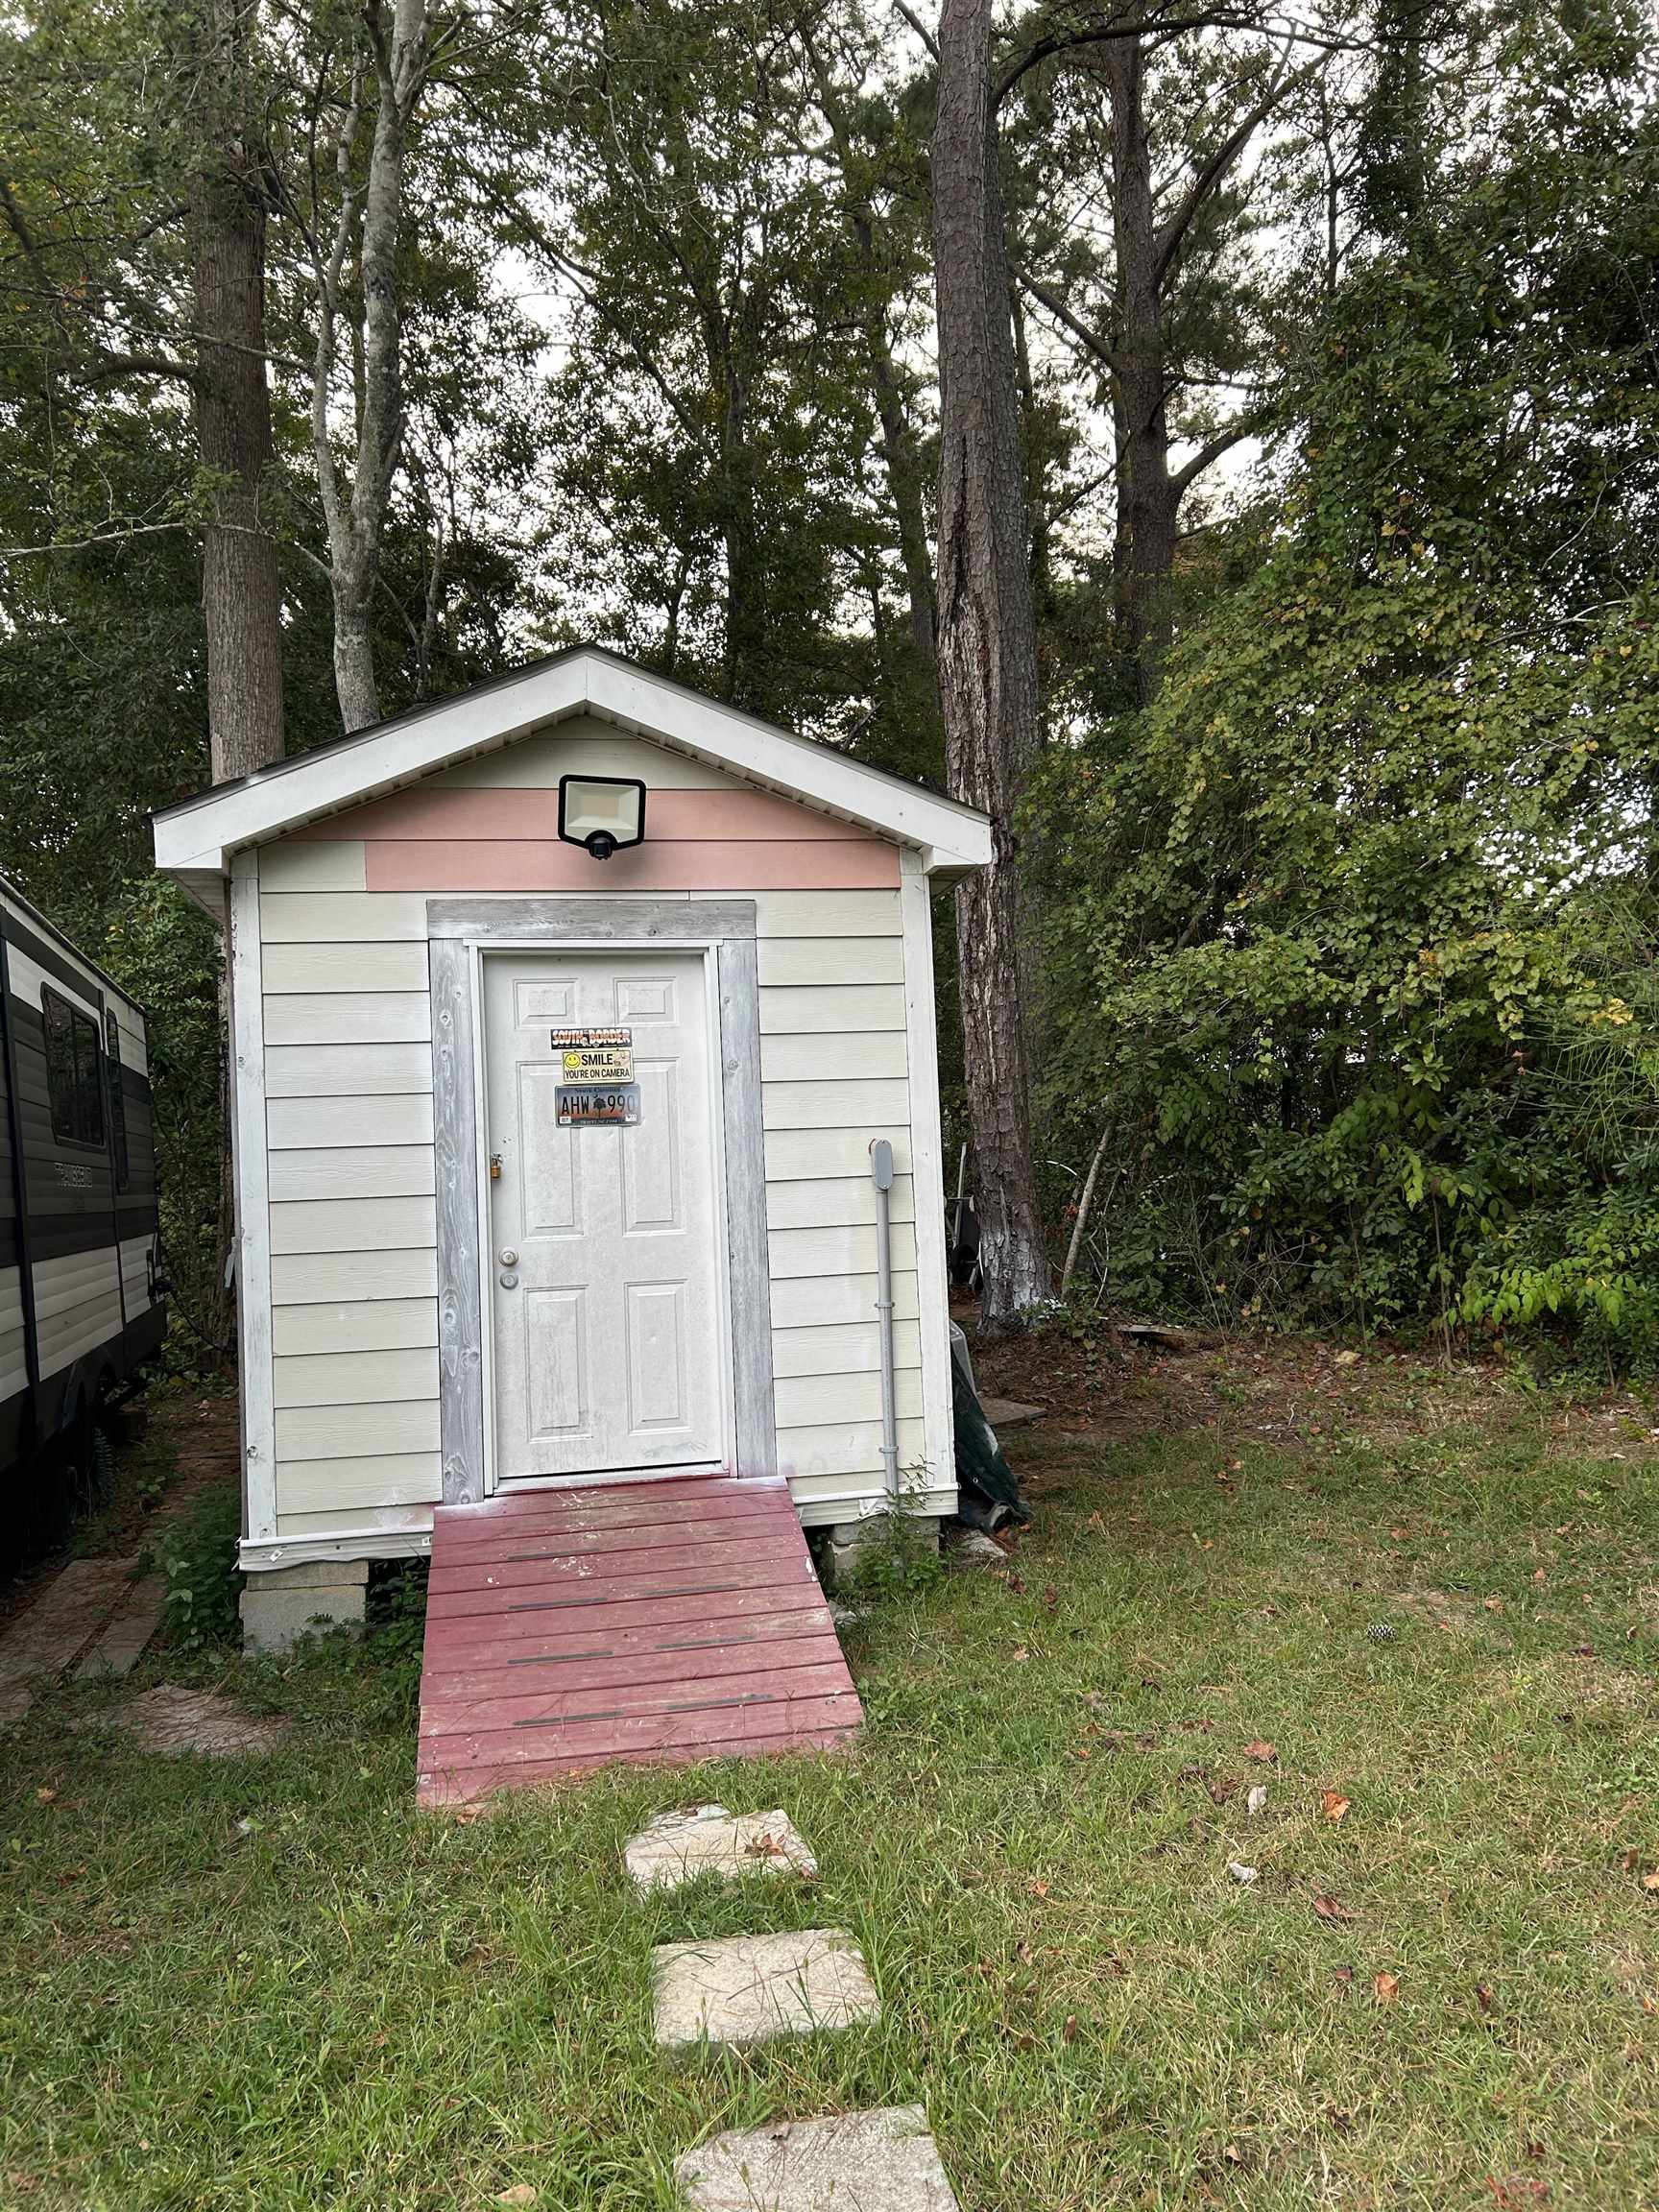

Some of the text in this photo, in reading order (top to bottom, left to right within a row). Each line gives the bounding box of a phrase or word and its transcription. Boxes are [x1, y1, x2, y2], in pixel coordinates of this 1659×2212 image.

[552, 1029, 584, 1046] SOUTH
[581, 1053, 613, 1067] SMILE
[565, 1068, 630, 1079] YOU'RE ON CAMERA
[561, 1095, 589, 1115] AHW
